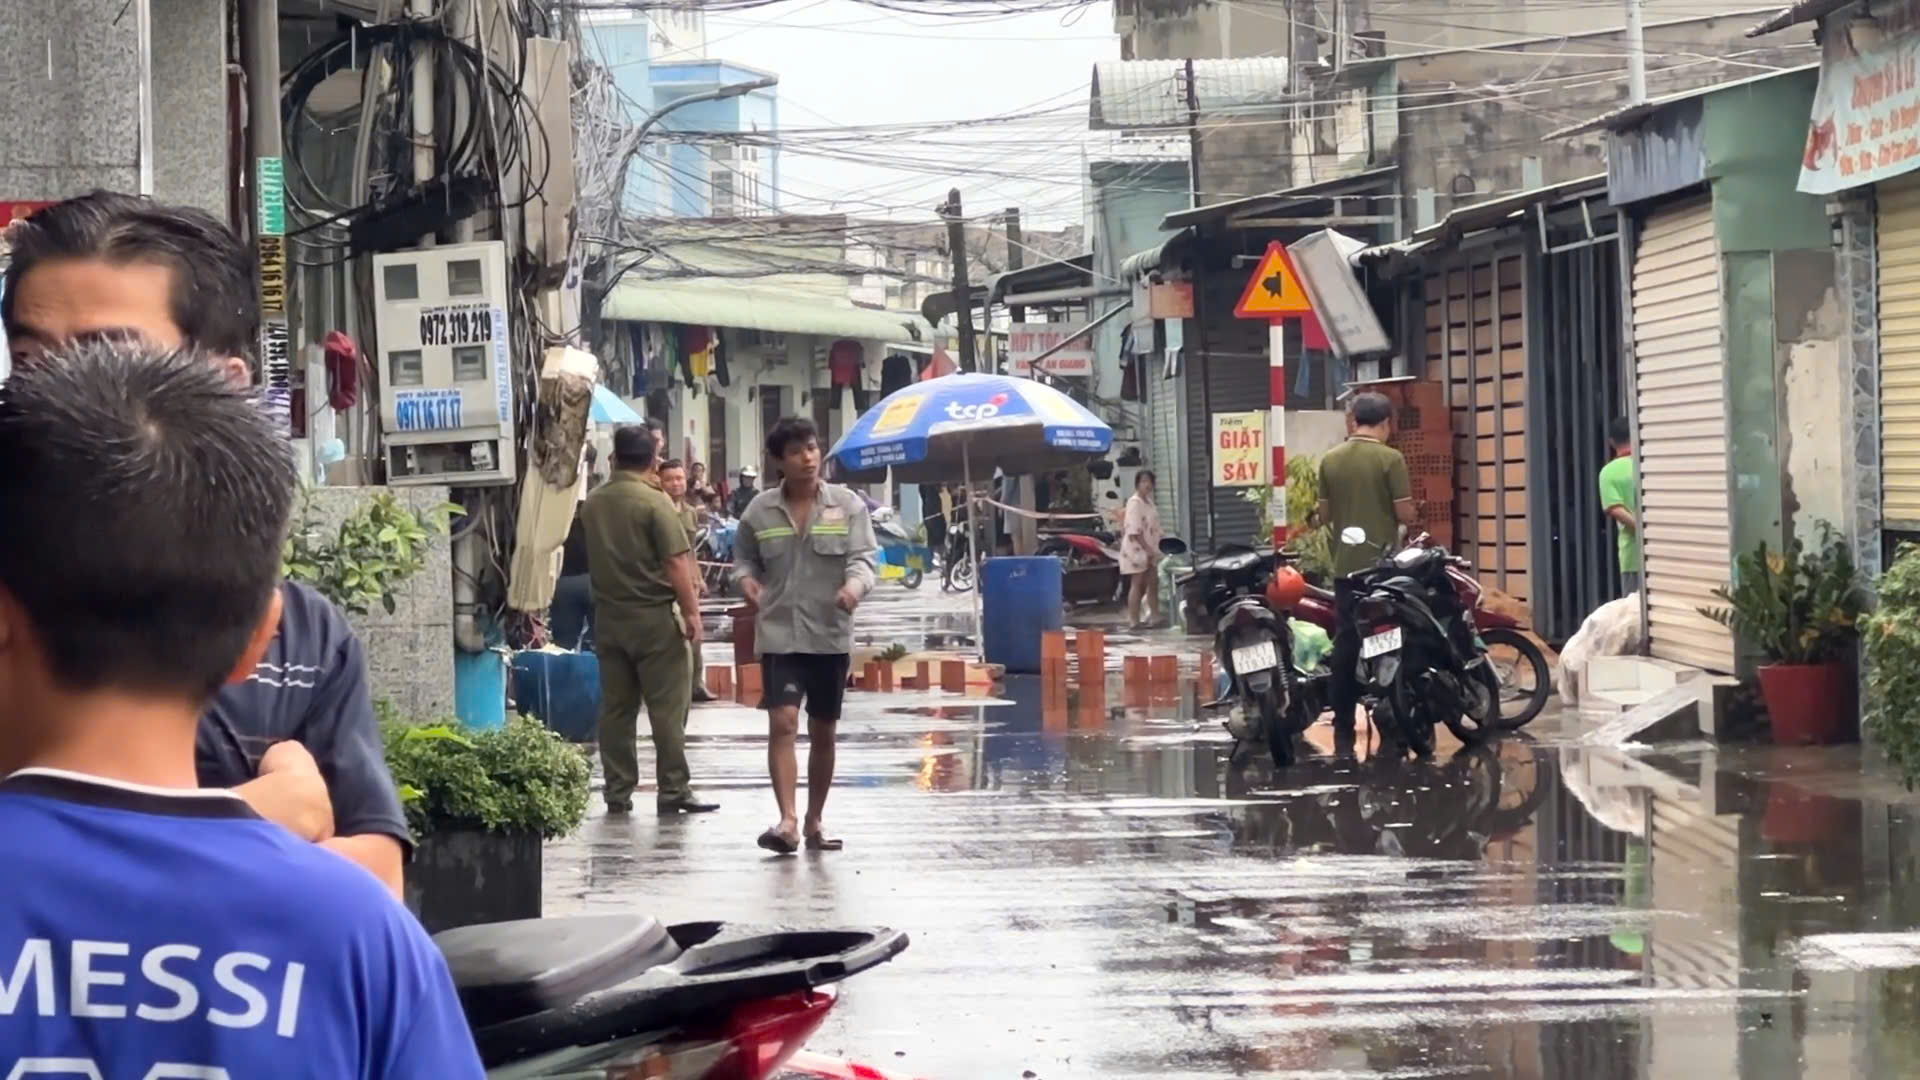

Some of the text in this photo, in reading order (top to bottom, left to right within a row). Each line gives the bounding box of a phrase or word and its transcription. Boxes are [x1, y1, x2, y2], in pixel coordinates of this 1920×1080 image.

[259, 238, 281, 266] 0964
[262, 269, 282, 282] 16
[262, 285, 282, 297] 16
[263, 300, 283, 311] 17
[420, 310, 492, 346] 0972 319 219
[396, 397, 462, 430] 0971 16 17 17
[944, 400, 999, 421] tcp
[1220, 426, 1262, 452] GIẶT
[1223, 456, 1259, 481] SẤY
[0, 938, 305, 1038] MESSI
